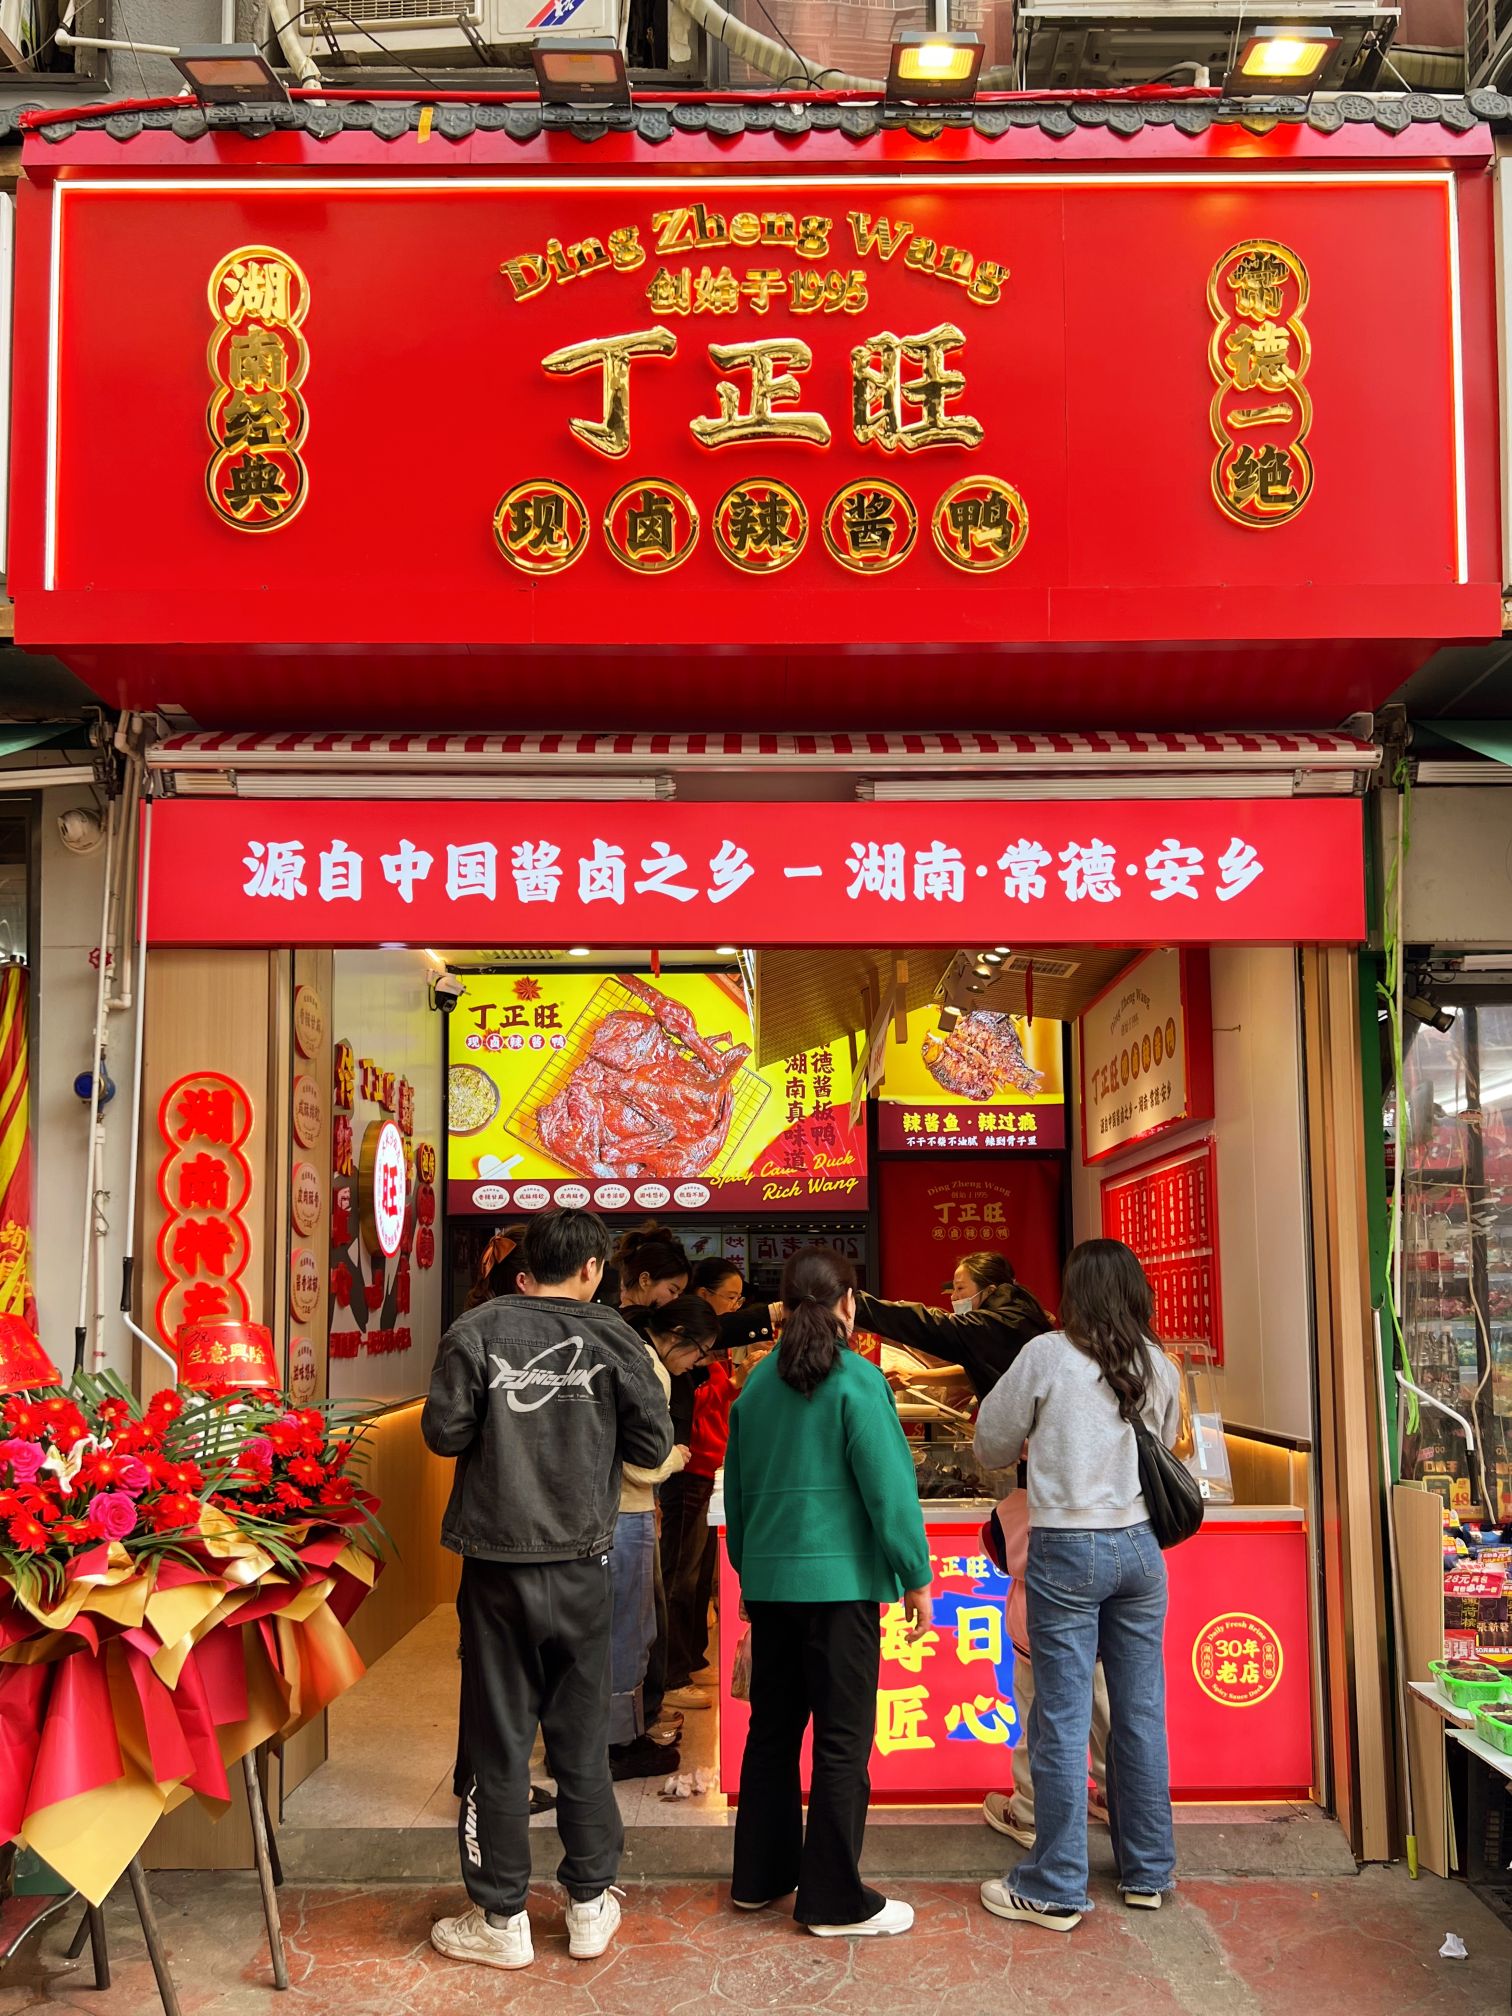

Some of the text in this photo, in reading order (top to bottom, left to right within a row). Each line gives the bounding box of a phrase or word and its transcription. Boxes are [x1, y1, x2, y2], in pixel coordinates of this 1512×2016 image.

[499, 203, 1010, 305] Ding Zheng Wang
[645, 266, 869, 316] 创始于1995
[223, 260, 291, 519] 湖南经典
[541, 322, 985, 459] 丁正旺
[1225, 249, 1298, 512] 常德一绝
[507, 490, 1015, 558] 现卤辣酱鸭
[467, 1003, 563, 1031] 丁正旺
[466, 1034, 566, 1050] 现卤辣酱鸭
[810, 1045, 836, 1147] 德酱板鸭
[784, 1052, 809, 1172] 湖南真味道
[902, 1112, 1038, 1133] 辣酱鱼·辣过瘾
[812, 1150, 856, 1170] Duck
[761, 1176, 859, 1201] Rich Wang
[951, 1180, 982, 1192] Zheng
[985, 1181, 1012, 1198] Wang
[933, 1201, 1007, 1225] 丁正旺
[879, 1601, 1003, 1673] 每日
[1207, 1620, 1267, 1642] Daily Fresh Brine
[1214, 1638, 1261, 1659] 30年
[1215, 1660, 1260, 1684] 老店
[1211, 1683, 1228, 1699] Spicy
[1248, 1684, 1264, 1697] Duck
[874, 1685, 1017, 1757] 匠心
